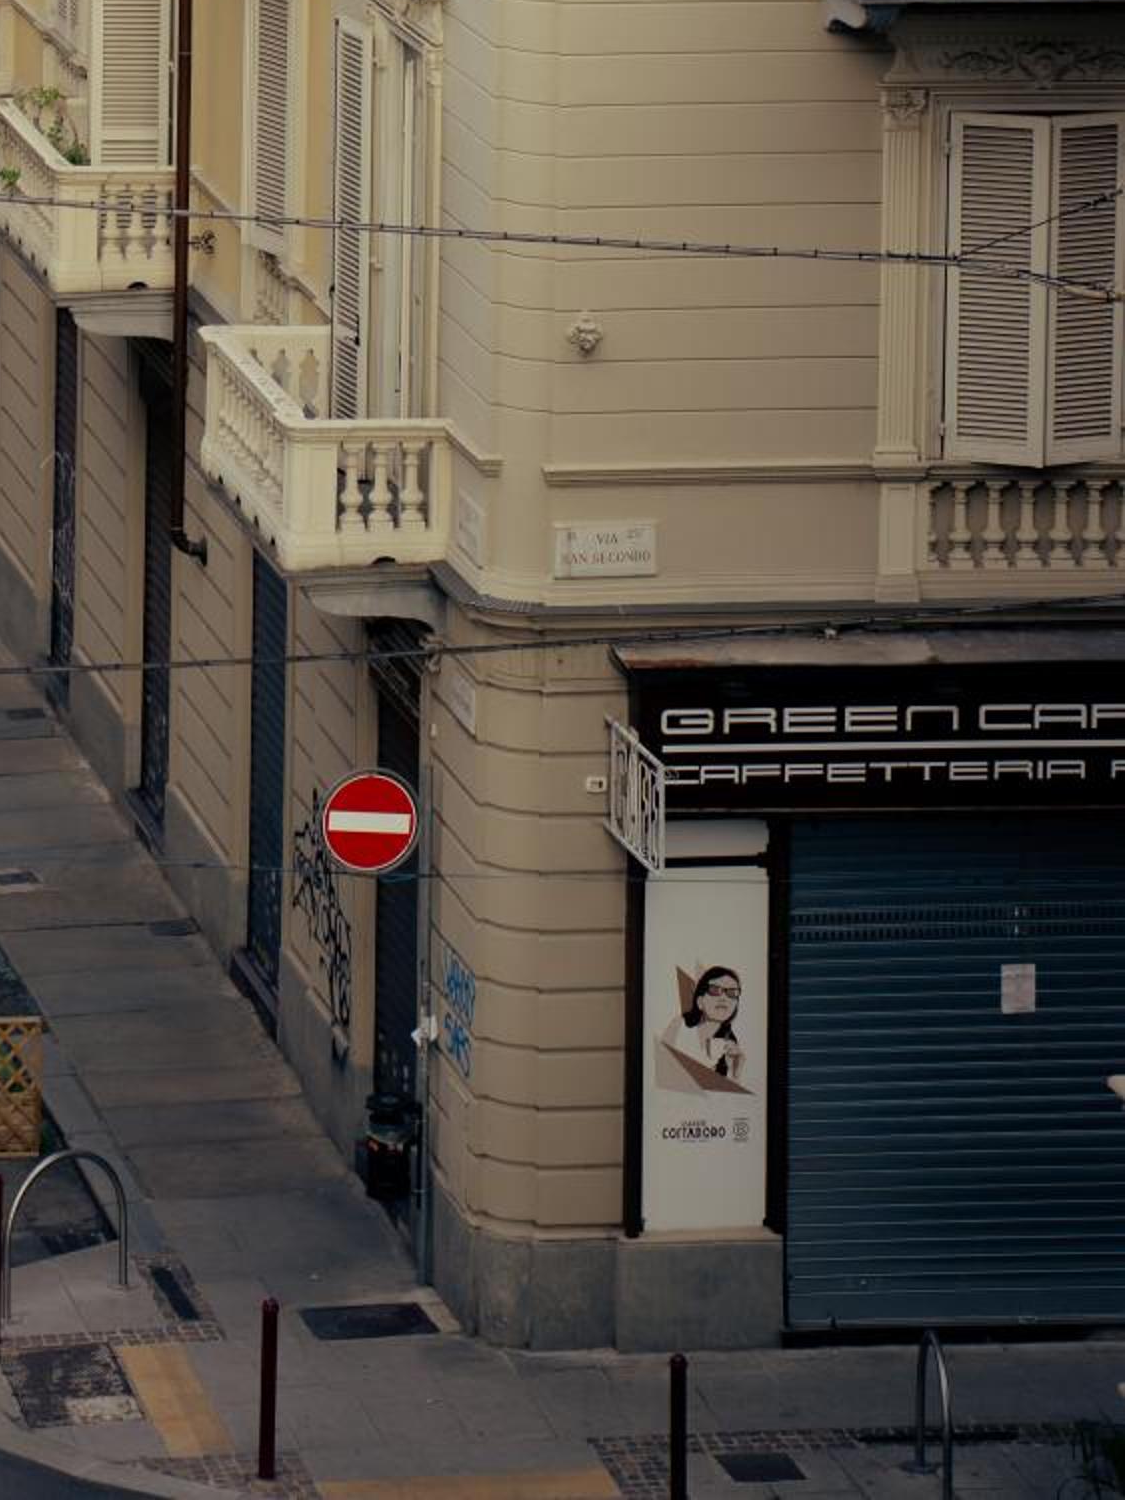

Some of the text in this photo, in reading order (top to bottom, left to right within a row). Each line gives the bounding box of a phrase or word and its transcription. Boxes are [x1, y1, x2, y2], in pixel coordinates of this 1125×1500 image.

[595, 532, 619, 545] VIA
[590, 549, 651, 565] SECONDO
[660, 705, 959, 735] GREEN
[664, 760, 1086, 785] CAFFETTERIA
